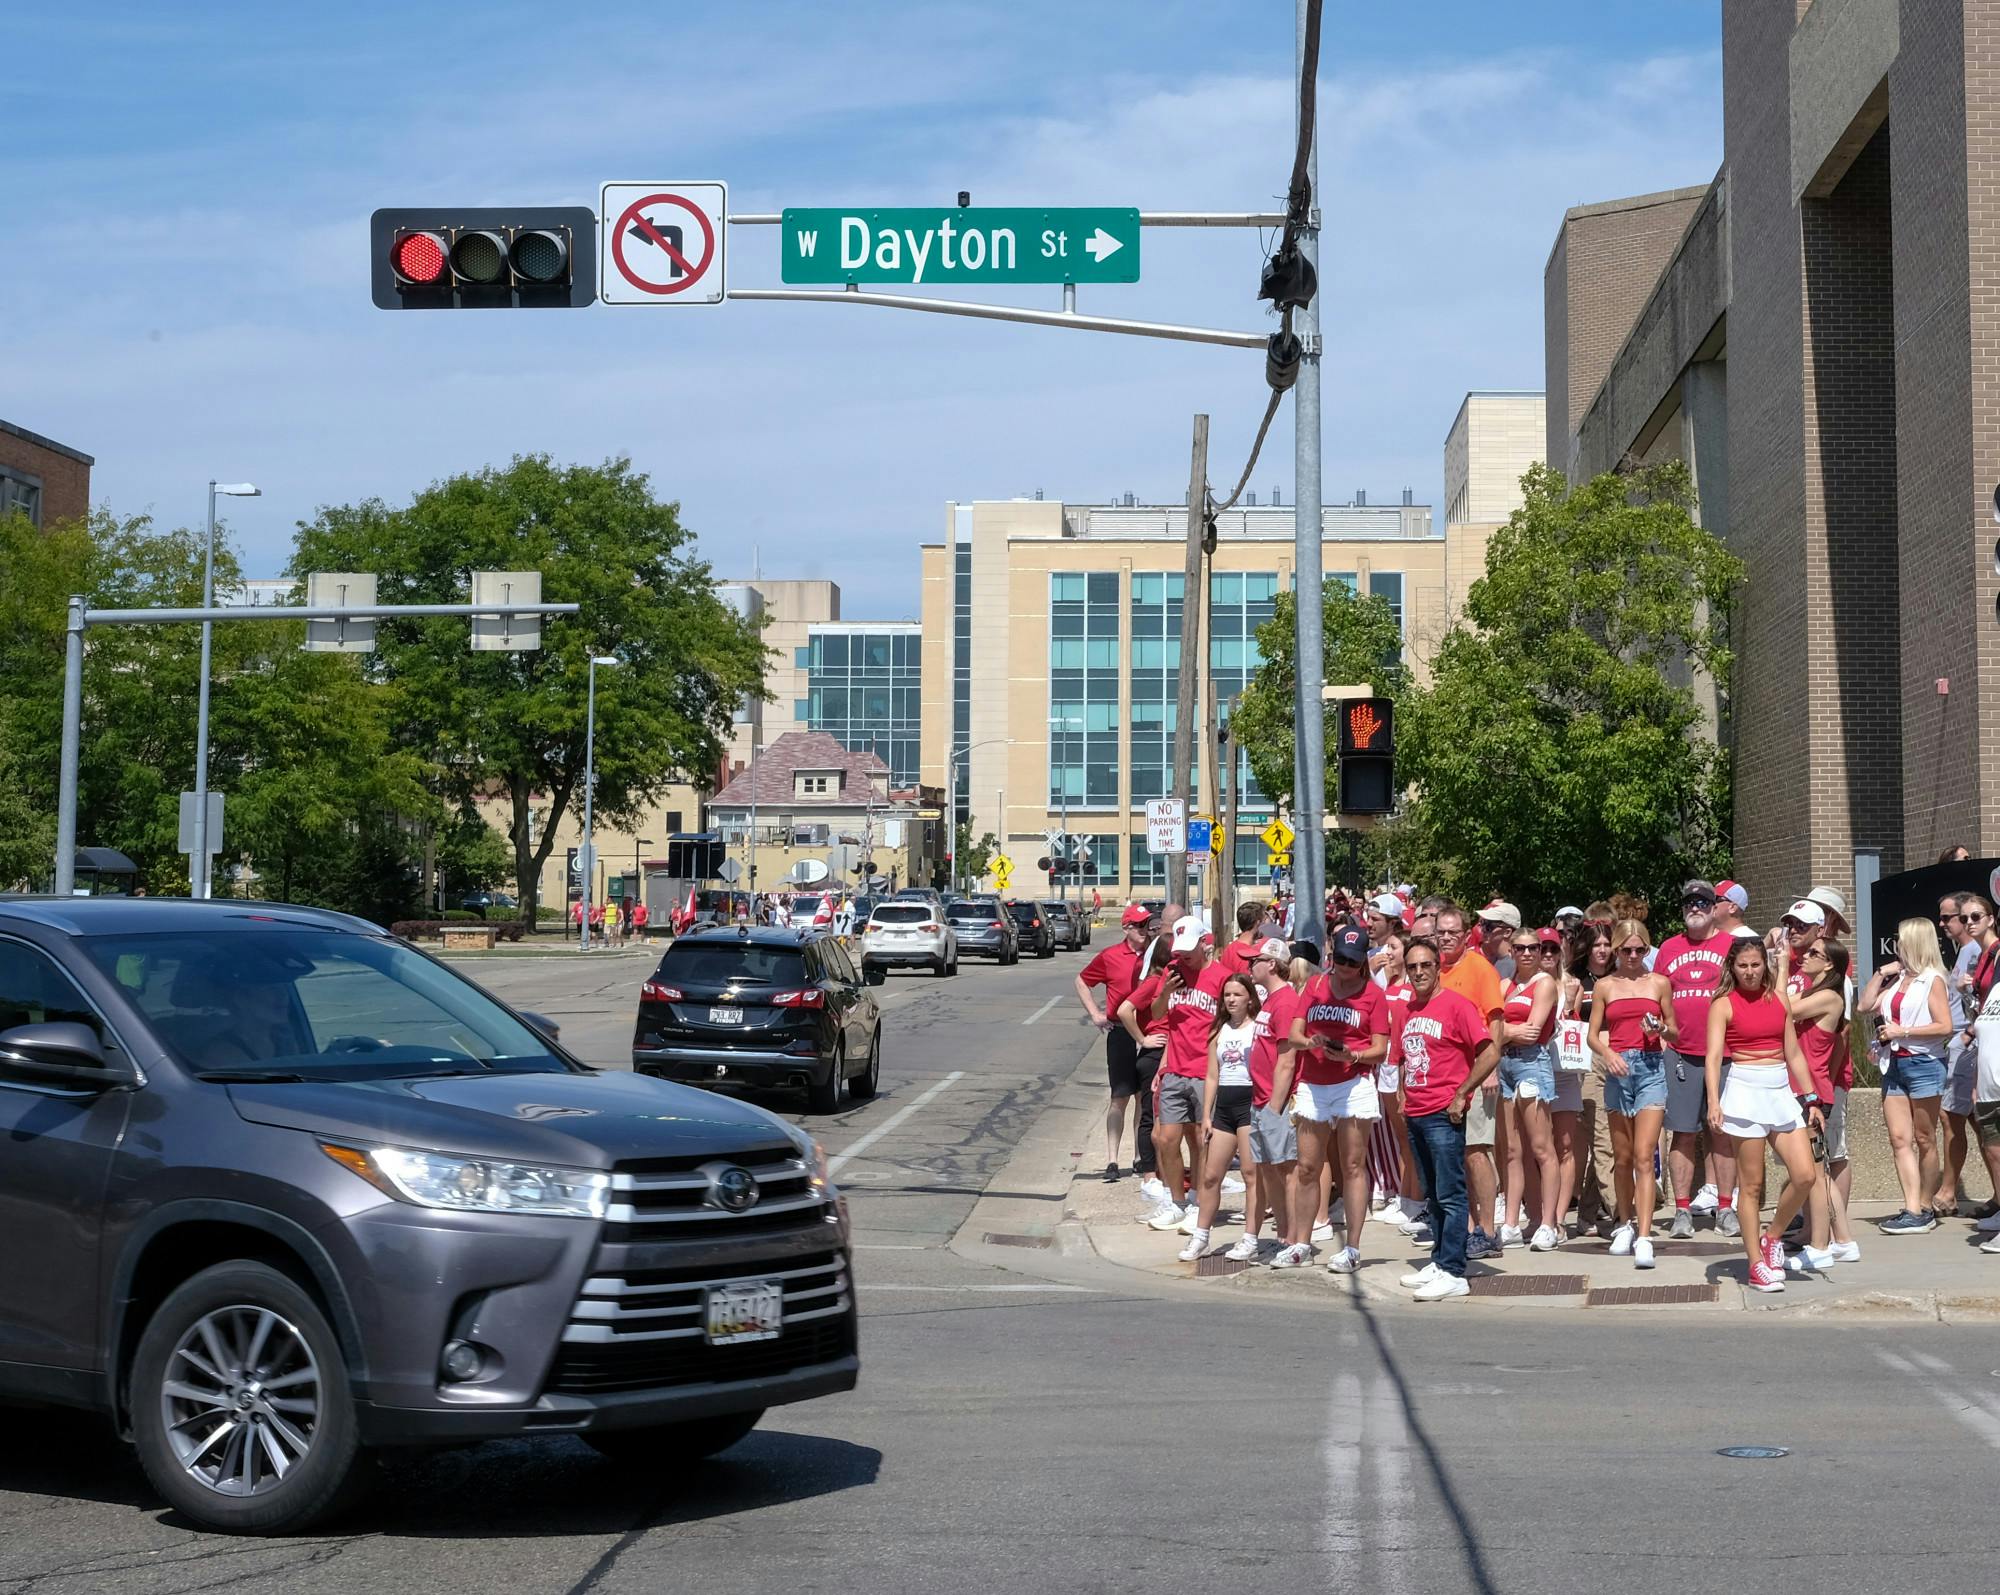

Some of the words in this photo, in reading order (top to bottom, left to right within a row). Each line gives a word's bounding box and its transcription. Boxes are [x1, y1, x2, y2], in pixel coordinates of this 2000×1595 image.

[797, 230, 818, 257] W
[841, 217, 1016, 284] Dayton
[1040, 230, 1068, 258] St
[1157, 802, 1172, 815] NO
[1149, 817, 1182, 827] PARKING
[1158, 828, 1174, 838] ANY
[1212, 833, 1221, 844] R
[1158, 839, 1175, 848] TIME
[1667, 950, 1725, 974] WISCONSI
[1690, 971, 1703, 979] W
[1308, 1004, 1361, 1028] WISCONSIN
[1402, 1017, 1443, 1040] SCONSIN
